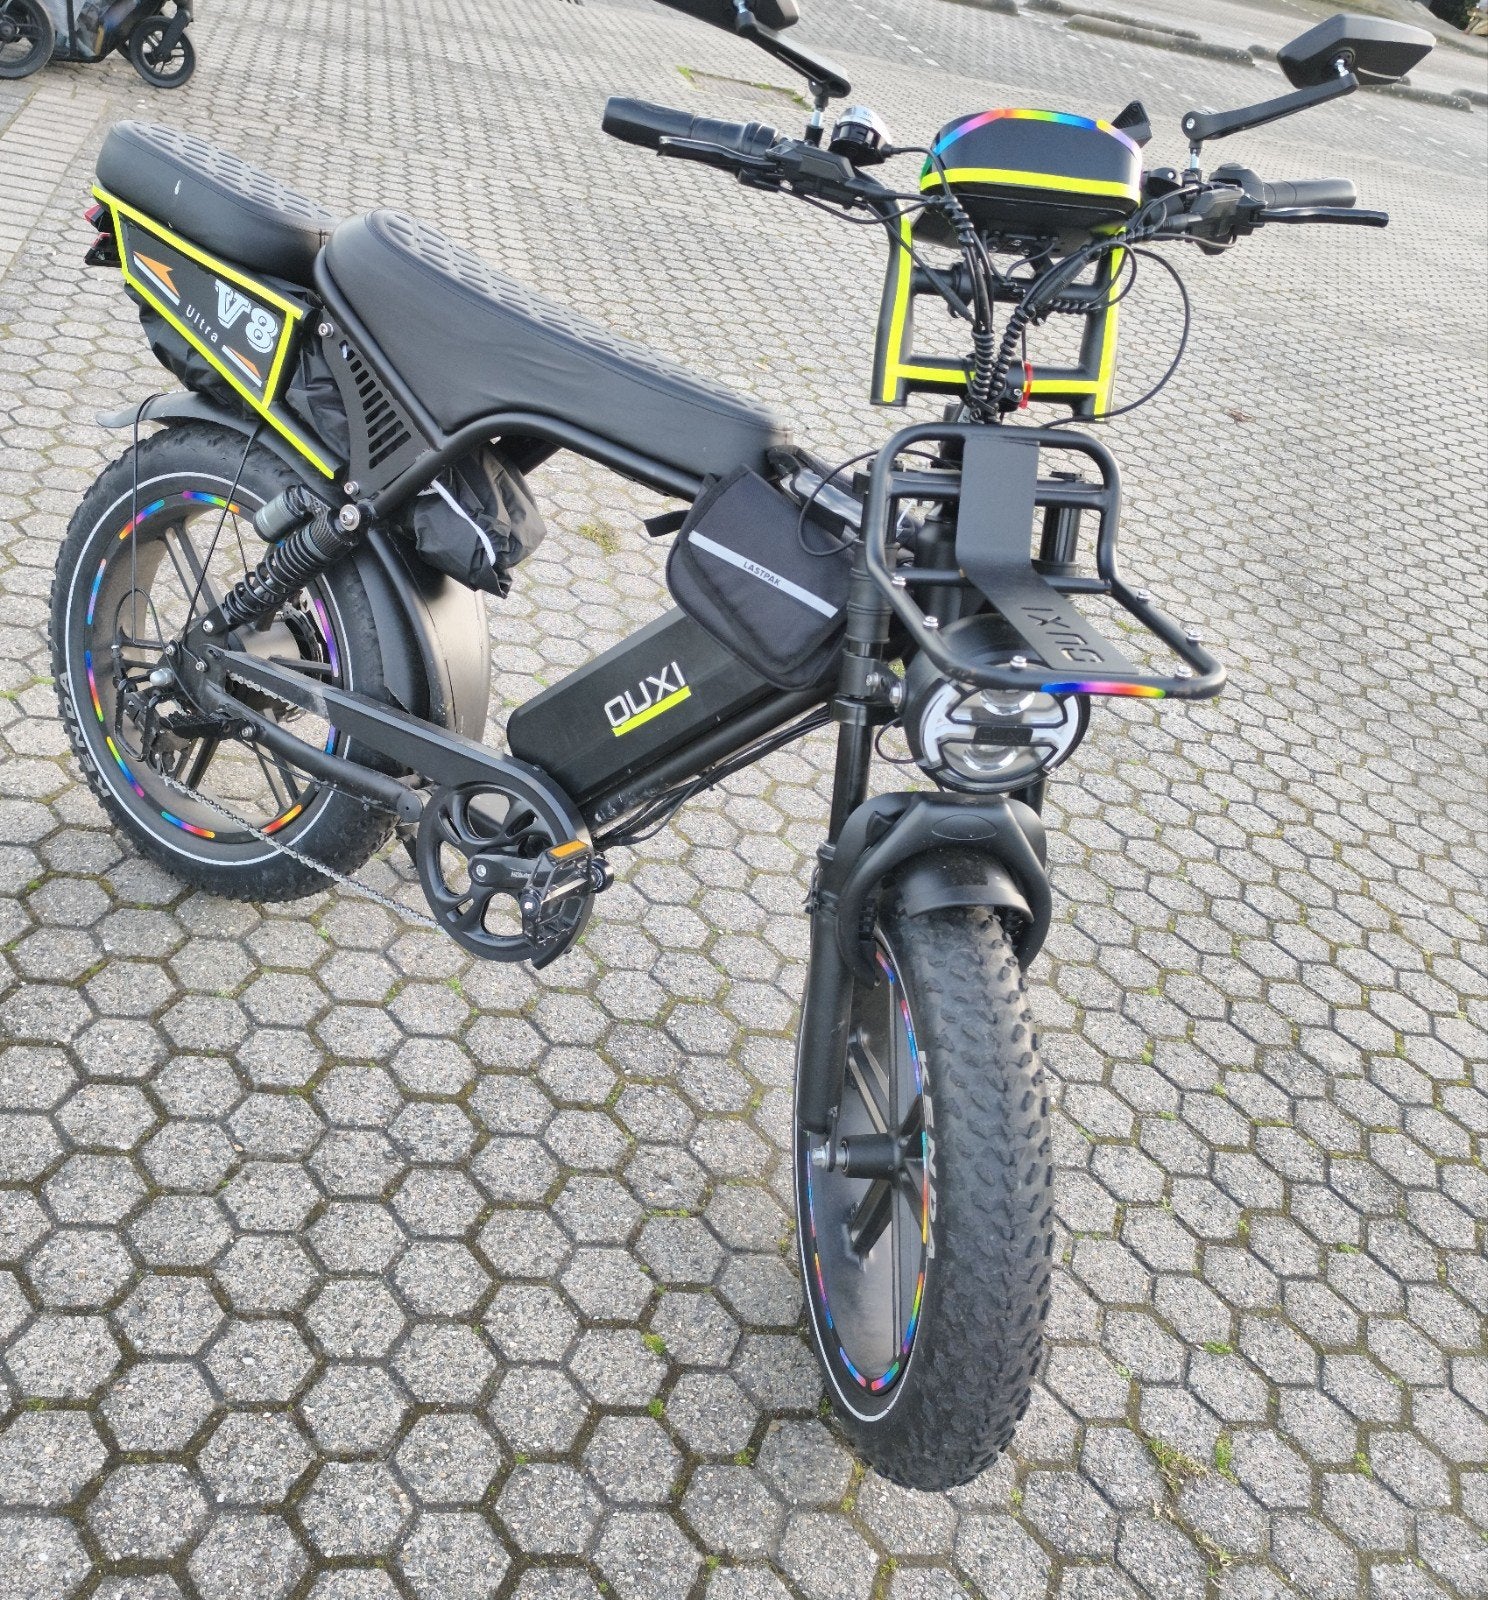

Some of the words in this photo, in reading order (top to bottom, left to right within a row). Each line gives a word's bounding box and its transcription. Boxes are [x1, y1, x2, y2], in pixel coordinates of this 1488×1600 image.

[186, 305, 218, 342] Ultra
[215, 279, 278, 353] V8
[604, 661, 685, 727] OUXI
[59, 672, 111, 798] KENDA
